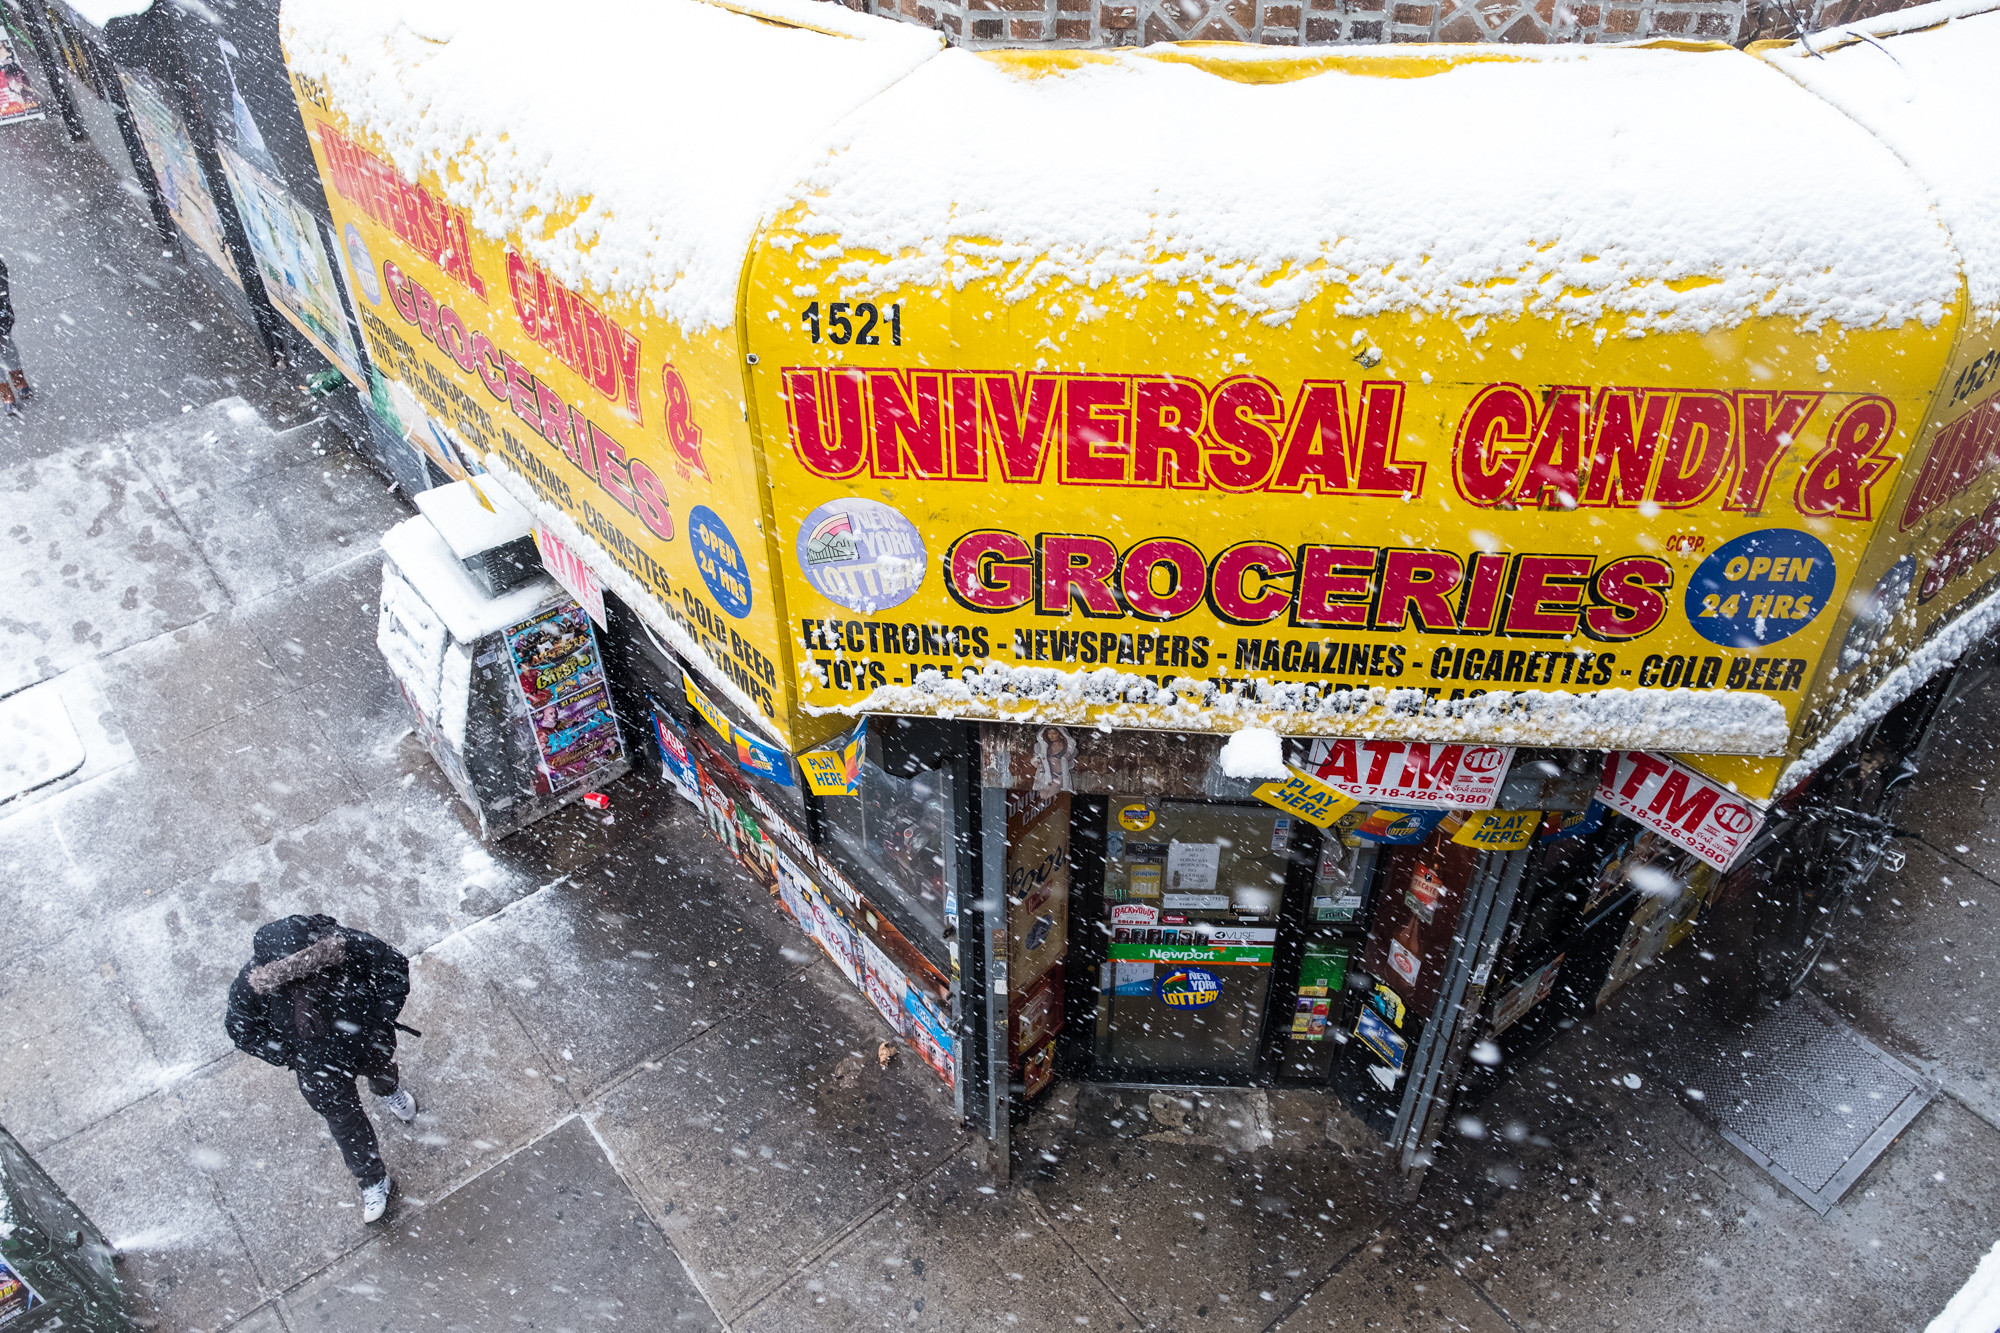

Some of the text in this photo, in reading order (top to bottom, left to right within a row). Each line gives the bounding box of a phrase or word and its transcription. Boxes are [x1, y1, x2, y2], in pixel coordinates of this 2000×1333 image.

[801, 301, 902, 346] 1521
[505, 244, 644, 428] CANDY
[662, 363, 712, 484] &
[383, 260, 674, 542] GROCERIES
[781, 366, 1903, 521] UNIVERSAL CANDY &
[423, 357, 496, 439] NEWSPAPERS
[502, 428, 573, 509] MAGAZINES
[583, 500, 671, 596] CIGARETTES
[683, 588, 727, 646] COLD
[730, 628, 777, 690] BEER
[851, 511, 900, 530] NEW
[700, 524, 738, 570] OPEN
[862, 532, 916, 558] YORK
[698, 550, 747, 606] 24 HRS
[1724, 557, 1814, 582] OPEN
[943, 528, 1673, 643] GROCERIES
[1697, 594, 1814, 619] 24 HRS
[802, 618, 1808, 691] ELECTRONICS NEWSPAPERS MAGAZINES CIGARETTES COLD BEER
[702, 634, 775, 718] STAMPS
[816, 658, 887, 691] TOYS
[807, 757, 836, 770] PLAY
[1315, 740, 1465, 791] ATM
[1466, 750, 1500, 768] $10
[814, 772, 846, 786] HERE
[1287, 777, 1340, 807] PLAY
[1274, 788, 1328, 821] HERE.
[1369, 787, 1487, 804] 718-426-9380
[1483, 815, 1527, 830] PLAY
[1619, 797, 1726, 864] 718-426-9380
[1716, 806, 1751, 832] $10
[1472, 829, 1525, 844] HERE.
[818, 855, 861, 910] CANDY
[1114, 905, 1156, 921] BACKWOODS
[1227, 932, 1255, 940] VUSE
[1150, 949, 1215, 961] Newport
[1189, 972, 1211, 981] NEW
[1190, 980, 1217, 991] YORK
[1162, 990, 1219, 1006] LOTTERY
